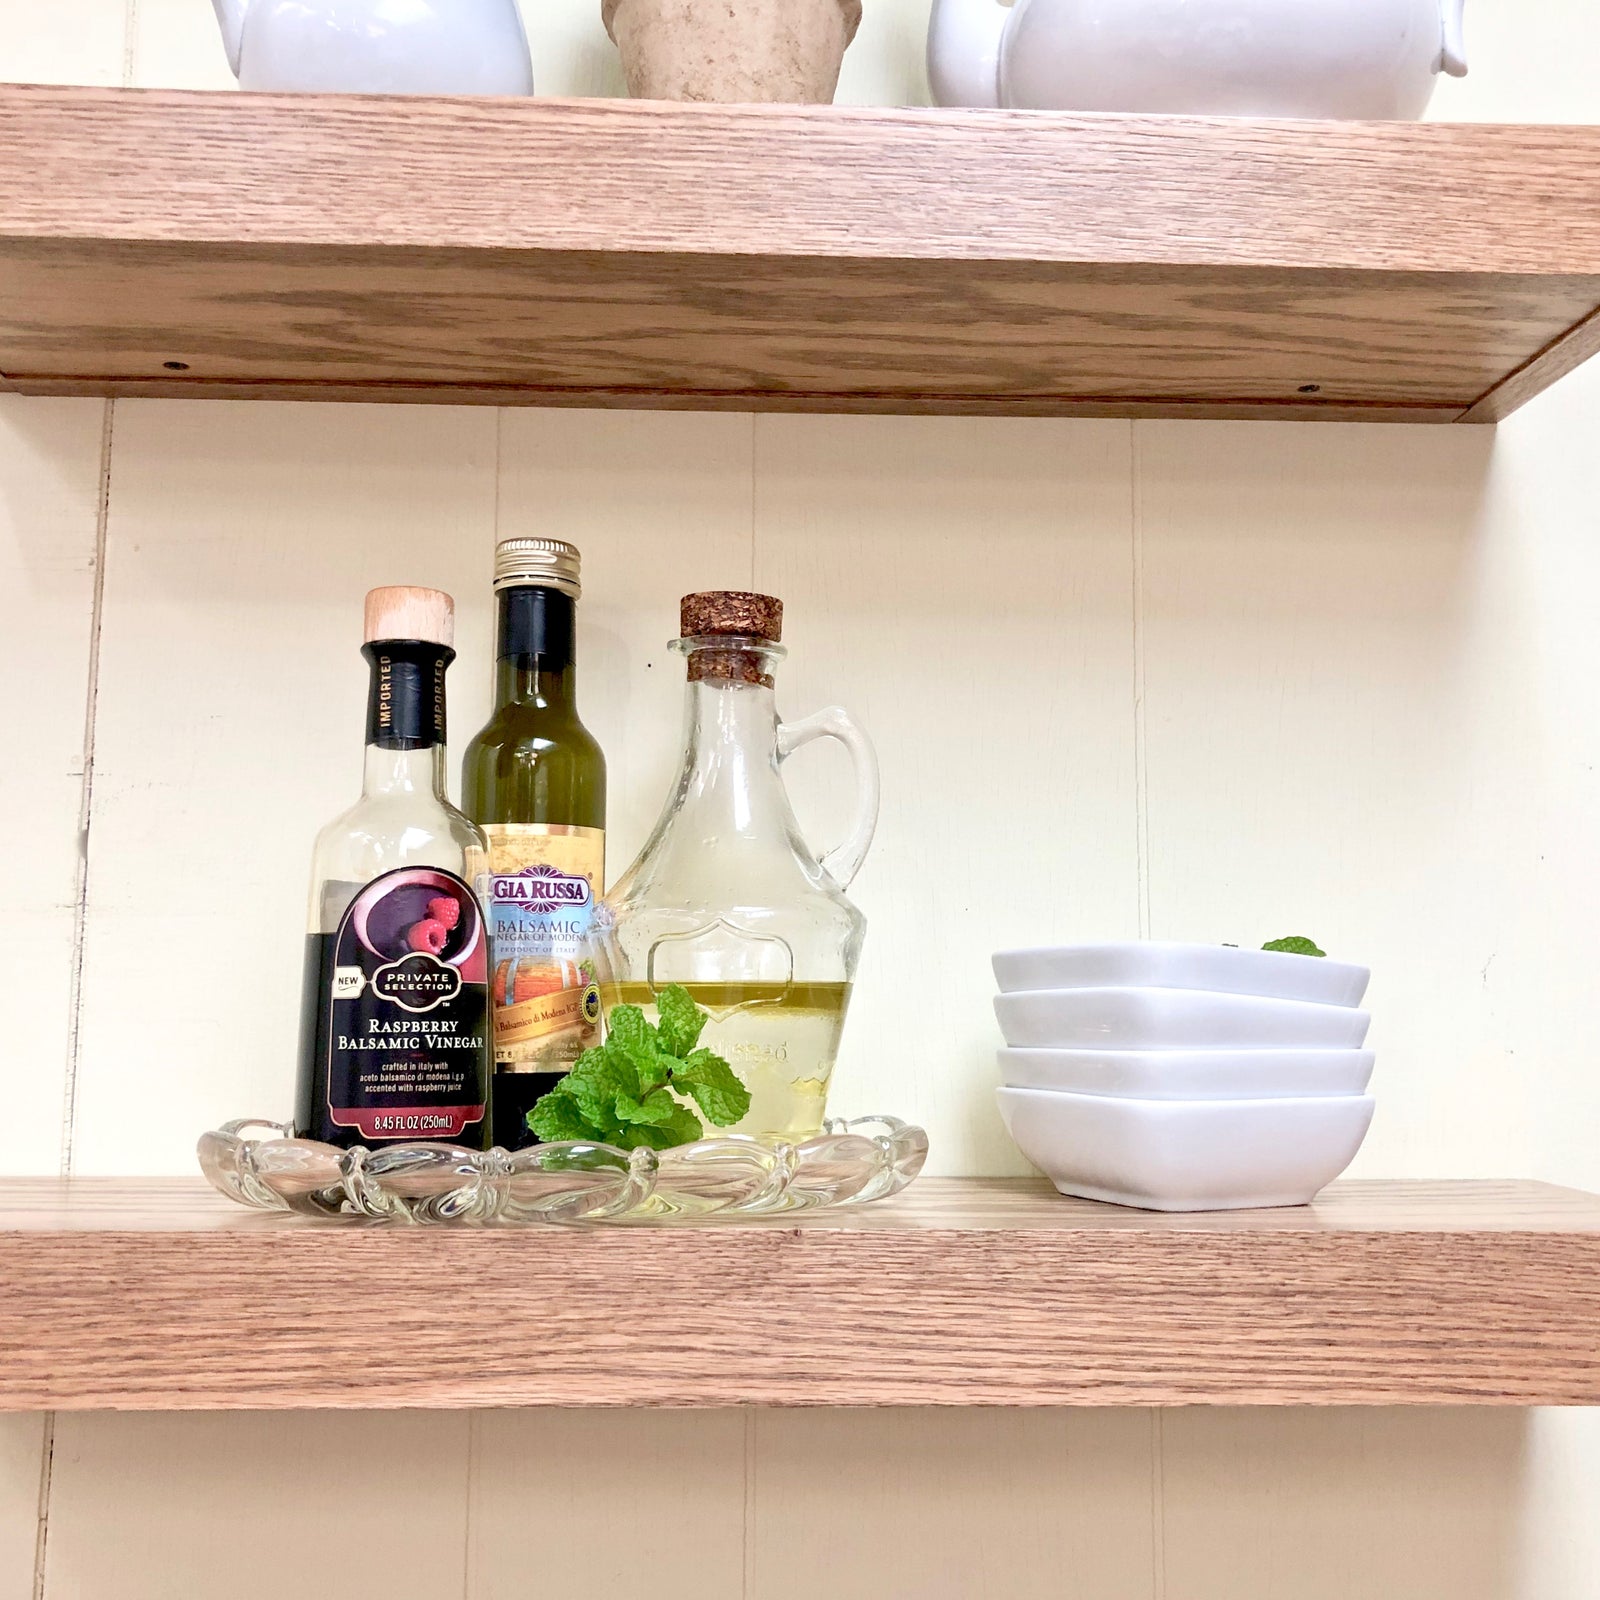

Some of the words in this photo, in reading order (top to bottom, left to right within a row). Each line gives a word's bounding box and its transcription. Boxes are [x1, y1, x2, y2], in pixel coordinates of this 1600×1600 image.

[380, 655, 392, 728] IMPORTED
[434, 659, 444, 730] IMPORTED
[494, 880, 527, 898] GIA
[531, 881, 585, 900] RUSSA
[498, 920, 580, 933] BALSAMIC
[496, 933, 530, 941] NEGAR
[532, 933, 545, 941] OF
[338, 977, 359, 985] NEW
[387, 974, 449, 982] PRIVATE
[368, 1019, 459, 1033] RASPBERRY
[500, 1018, 532, 1032] Balsamico
[542, 1008, 566, 1021] Modena
[338, 1036, 420, 1050] BALSAMIC
[424, 1034, 484, 1049] VINEGAR
[382, 1062, 407, 1071] crafted
[410, 1062, 416, 1070] in
[434, 1062, 448, 1070] with
[360, 1074, 378, 1082] aceto
[380, 1073, 416, 1081] balsamico
[426, 1072, 450, 1081] modena
[365, 1084, 396, 1092] accented
[398, 1083, 413, 1091] with
[415, 1083, 446, 1093] raspberry
[447, 1082, 461, 1092] juice
[375, 1116, 394, 1130] 8.45
[396, 1116, 405, 1129] FL
[407, 1116, 418, 1129] OZ
[420, 1115, 453, 1130] (250mL)
